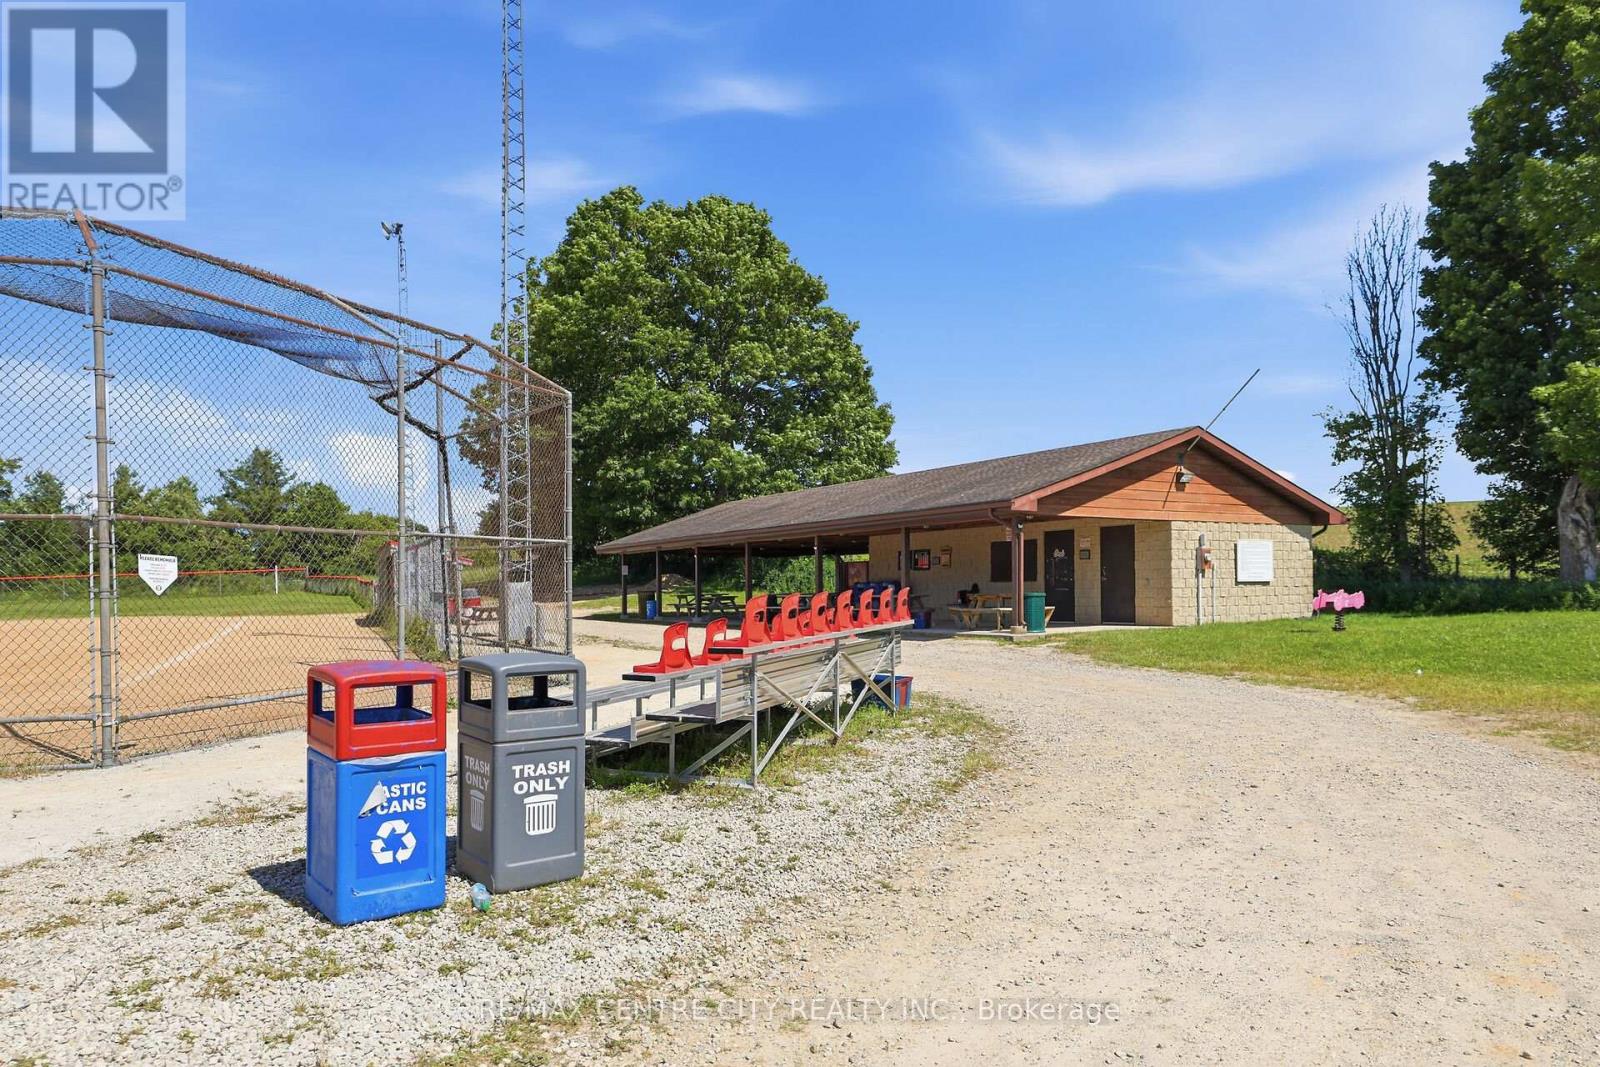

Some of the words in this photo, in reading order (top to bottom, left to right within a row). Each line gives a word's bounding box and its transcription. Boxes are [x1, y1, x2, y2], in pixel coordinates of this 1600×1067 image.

[464, 755, 490, 777] TRASH
[511, 759, 571, 779] TRASH
[382, 781, 427, 799] ASTIC
[465, 771, 490, 792] ONLY
[513, 775, 570, 795] ONLY
[376, 797, 427, 816] CANS
